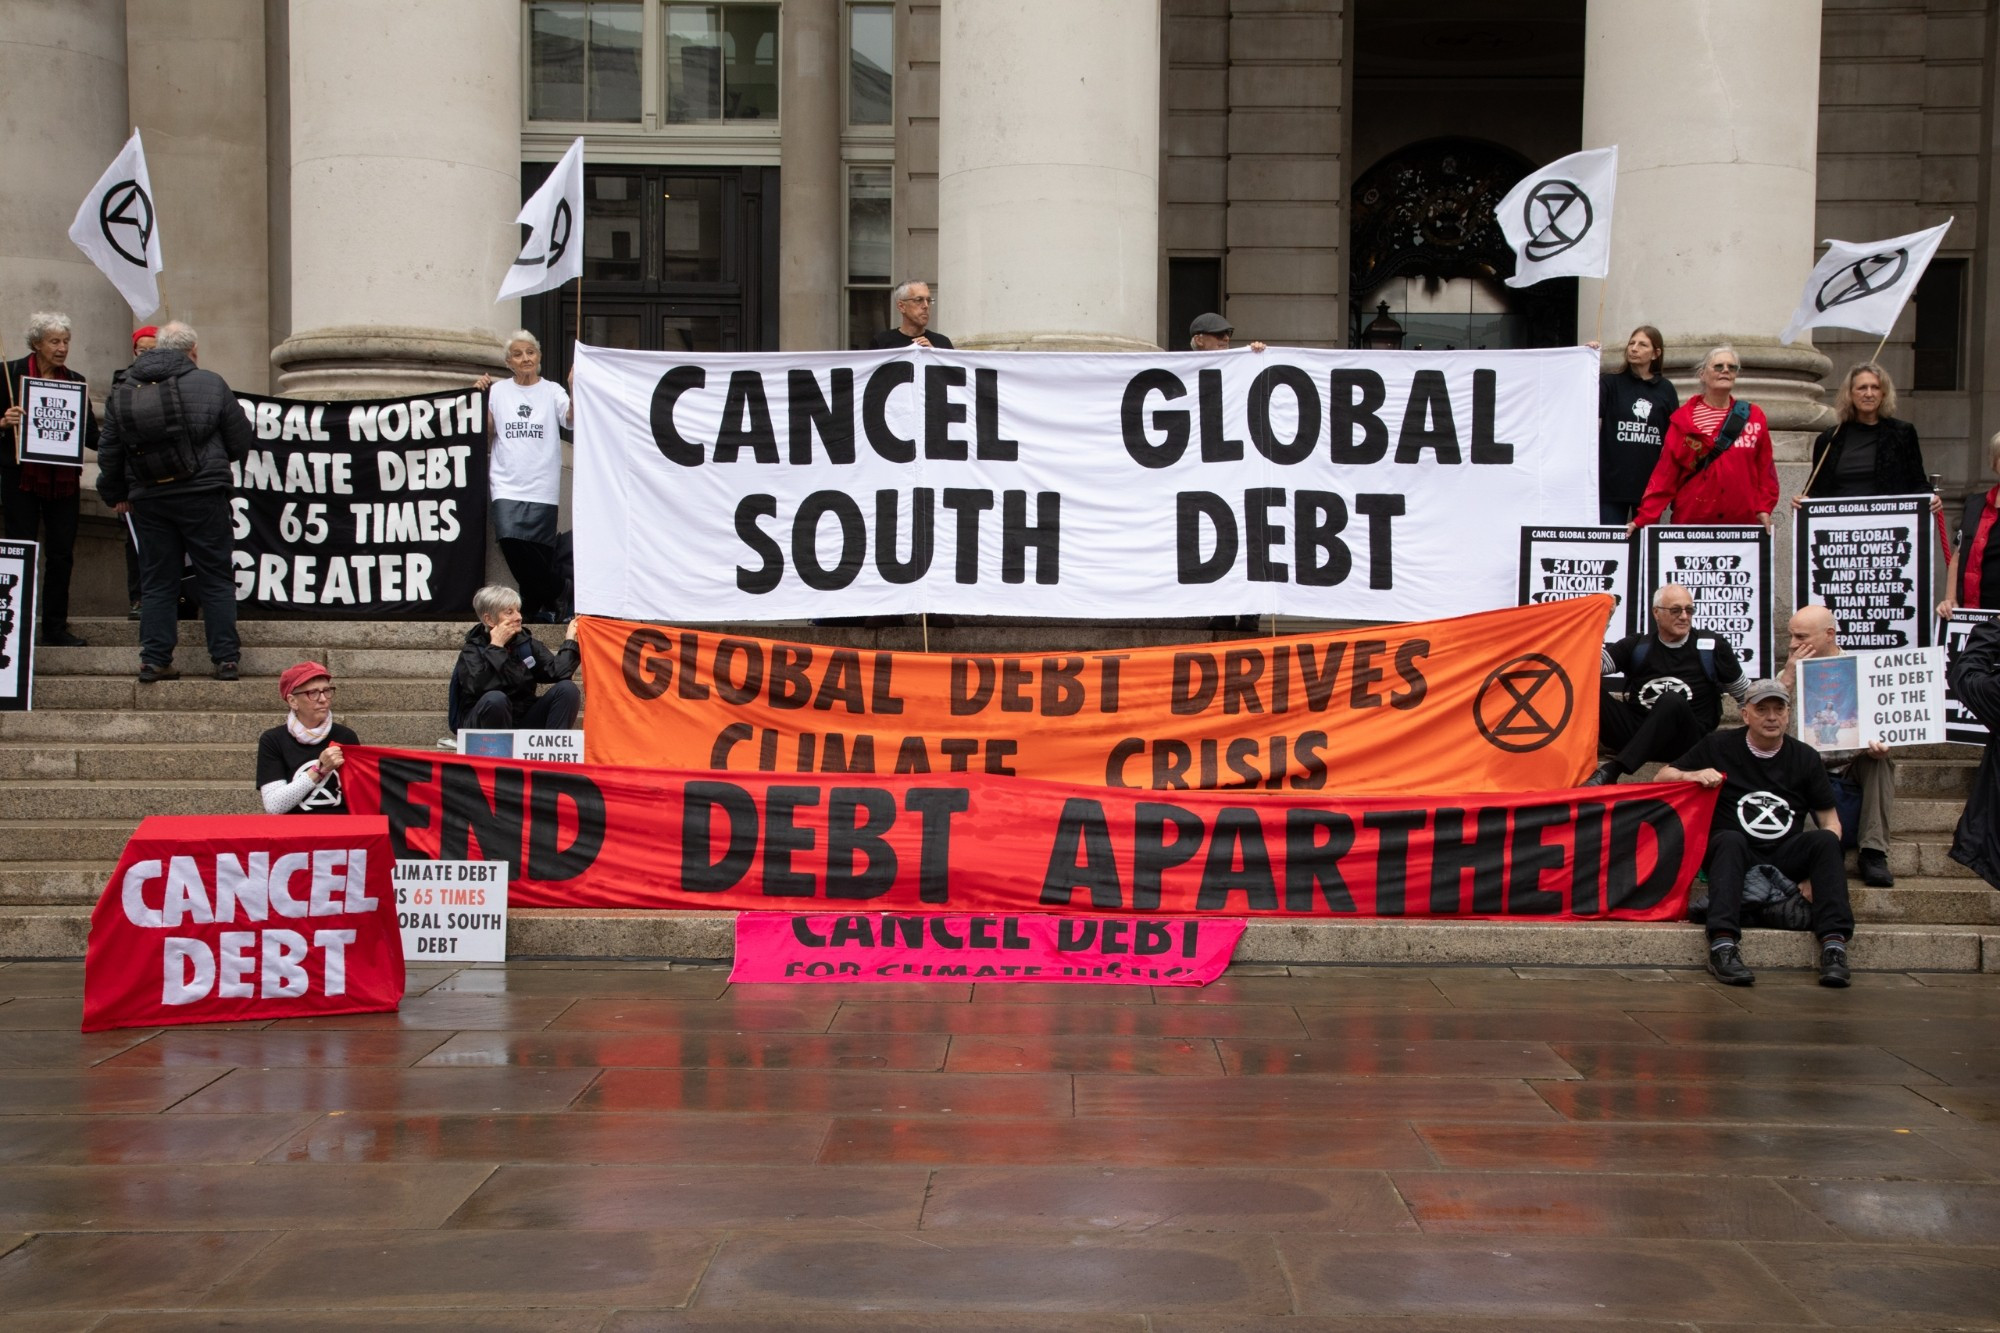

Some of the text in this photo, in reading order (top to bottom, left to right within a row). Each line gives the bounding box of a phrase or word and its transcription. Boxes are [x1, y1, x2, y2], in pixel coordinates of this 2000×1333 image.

[46, 398, 63, 408] BIN
[36, 408, 72, 420] GLOBAL
[237, 392, 482, 441] BAL NORTH
[650, 360, 1514, 469] CANCEL GLOBAL
[38, 420, 70, 430] SOUTH
[506, 422, 528, 430] DEBT
[1618, 421, 1647, 432] DEBT
[1744, 422, 1761, 434] OP
[42, 430, 65, 440] DEBT
[506, 430, 544, 439] CLIMATE
[1616, 432, 1662, 445] CLIMATE
[230, 446, 471, 494] IMATE DEBT
[1808, 502, 1918, 514] CANCEL GLOBAL SOUTH DEBT
[230, 497, 460, 544] S 65 TIMES
[734, 487, 1406, 595] SOUTH DEBT
[1532, 530, 1557, 539] CANCEL
[1559, 531, 1586, 539] GLOBAL
[1588, 531, 1610, 539] SOUTH
[1742, 531, 1759, 539] DEBT
[1828, 530, 1895, 542] THE GLOBAL
[8, 547, 24, 555] DEBT
[1819, 543, 1905, 556] NORTH OWES A
[1554, 560, 1605, 575] 54 LOW
[1684, 557, 1733, 570] 90% OF
[1823, 556, 1901, 569] CLIMATE DEBT.
[232, 550, 432, 604] GREATER
[1671, 572, 1748, 585] LENDING TO
[1831, 569, 1892, 581] AND ITS 65
[1553, 576, 1605, 590] INCOME
[1820, 582, 1905, 595] TIMES GREATER
[1701, 587, 1751, 601] INCOME
[1835, 595, 1889, 607] THAN THE
[1833, 608, 1905, 620] OBAL SOUTH
[1692, 618, 1750, 632] NFORCED
[1848, 622, 1876, 633] DEBT
[1835, 634, 1898, 646] EPAYMENTS
[1874, 652, 1927, 669] CANCEL
[622, 628, 1431, 716] GLOBAL DEBT DRIVES
[1869, 670, 1934, 688] THE DEBT
[1878, 690, 1926, 706] OF THE
[1874, 709, 1930, 725] GLOBAL
[528, 735, 573, 747] CANCEL
[1879, 728, 1926, 743] SOUTH
[1105, 730, 1328, 790] CRISIS
[380, 758, 1685, 915] END DEBT APARTHEID
[394, 864, 498, 882] LIMATE DEBT
[122, 849, 379, 928] CANCEL
[413, 888, 432, 905] 65
[440, 888, 486, 905] TIMES
[398, 913, 501, 930] OBAL SOUTH
[792, 916, 1030, 949] CANCEL
[417, 937, 458, 953] DEBT
[162, 929, 356, 1005] DEBT
